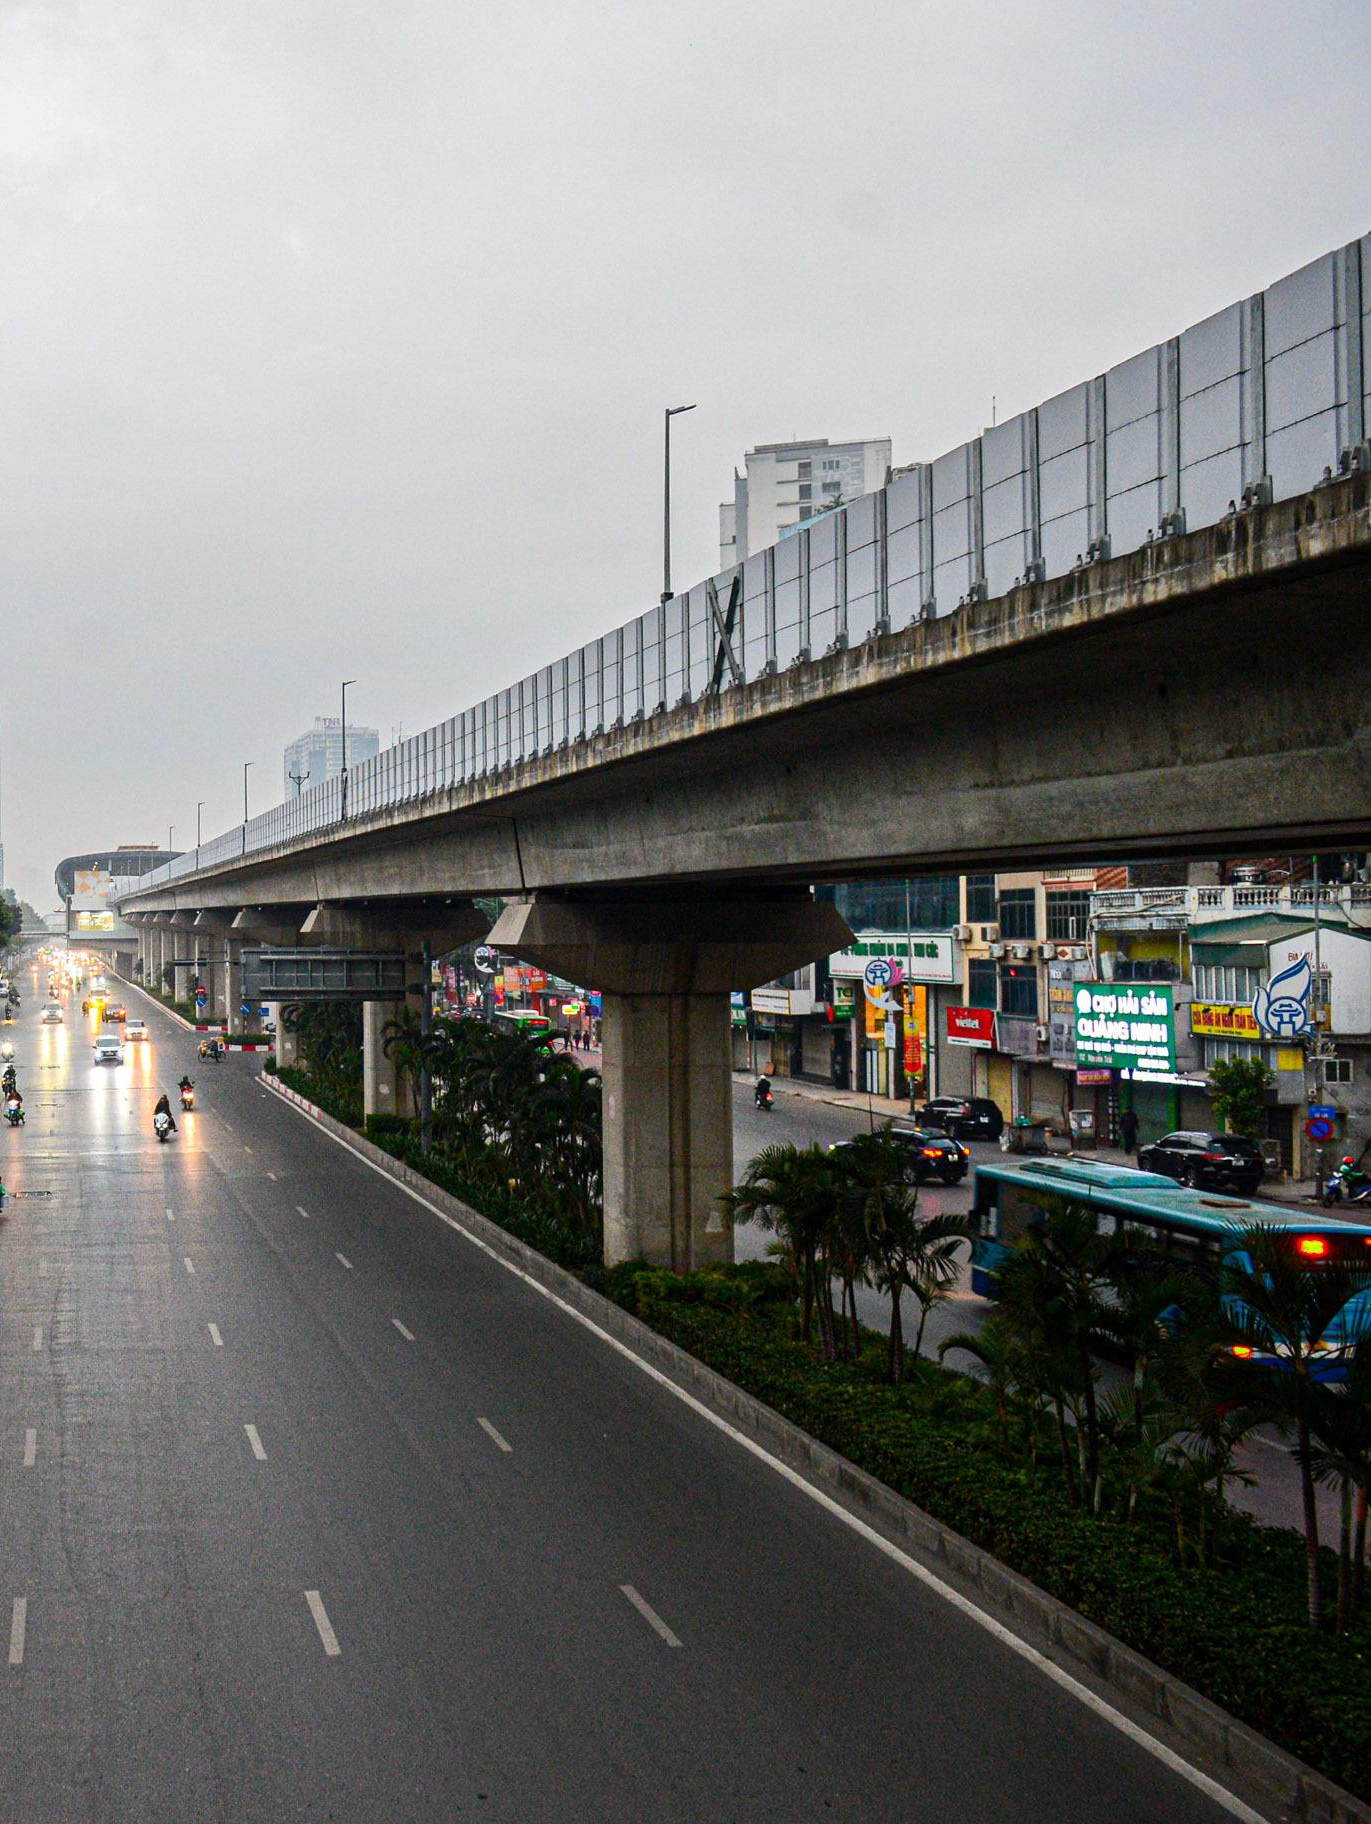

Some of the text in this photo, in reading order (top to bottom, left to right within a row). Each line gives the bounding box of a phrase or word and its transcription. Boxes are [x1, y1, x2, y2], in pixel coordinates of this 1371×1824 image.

[1092, 994, 1117, 1018] CHỢ
[1118, 989, 1140, 1015] HẢI
[1141, 990, 1168, 1016] SẢN
[955, 1016, 980, 1029] viettel
[1077, 1013, 1168, 1043] QUẢNG NINH
